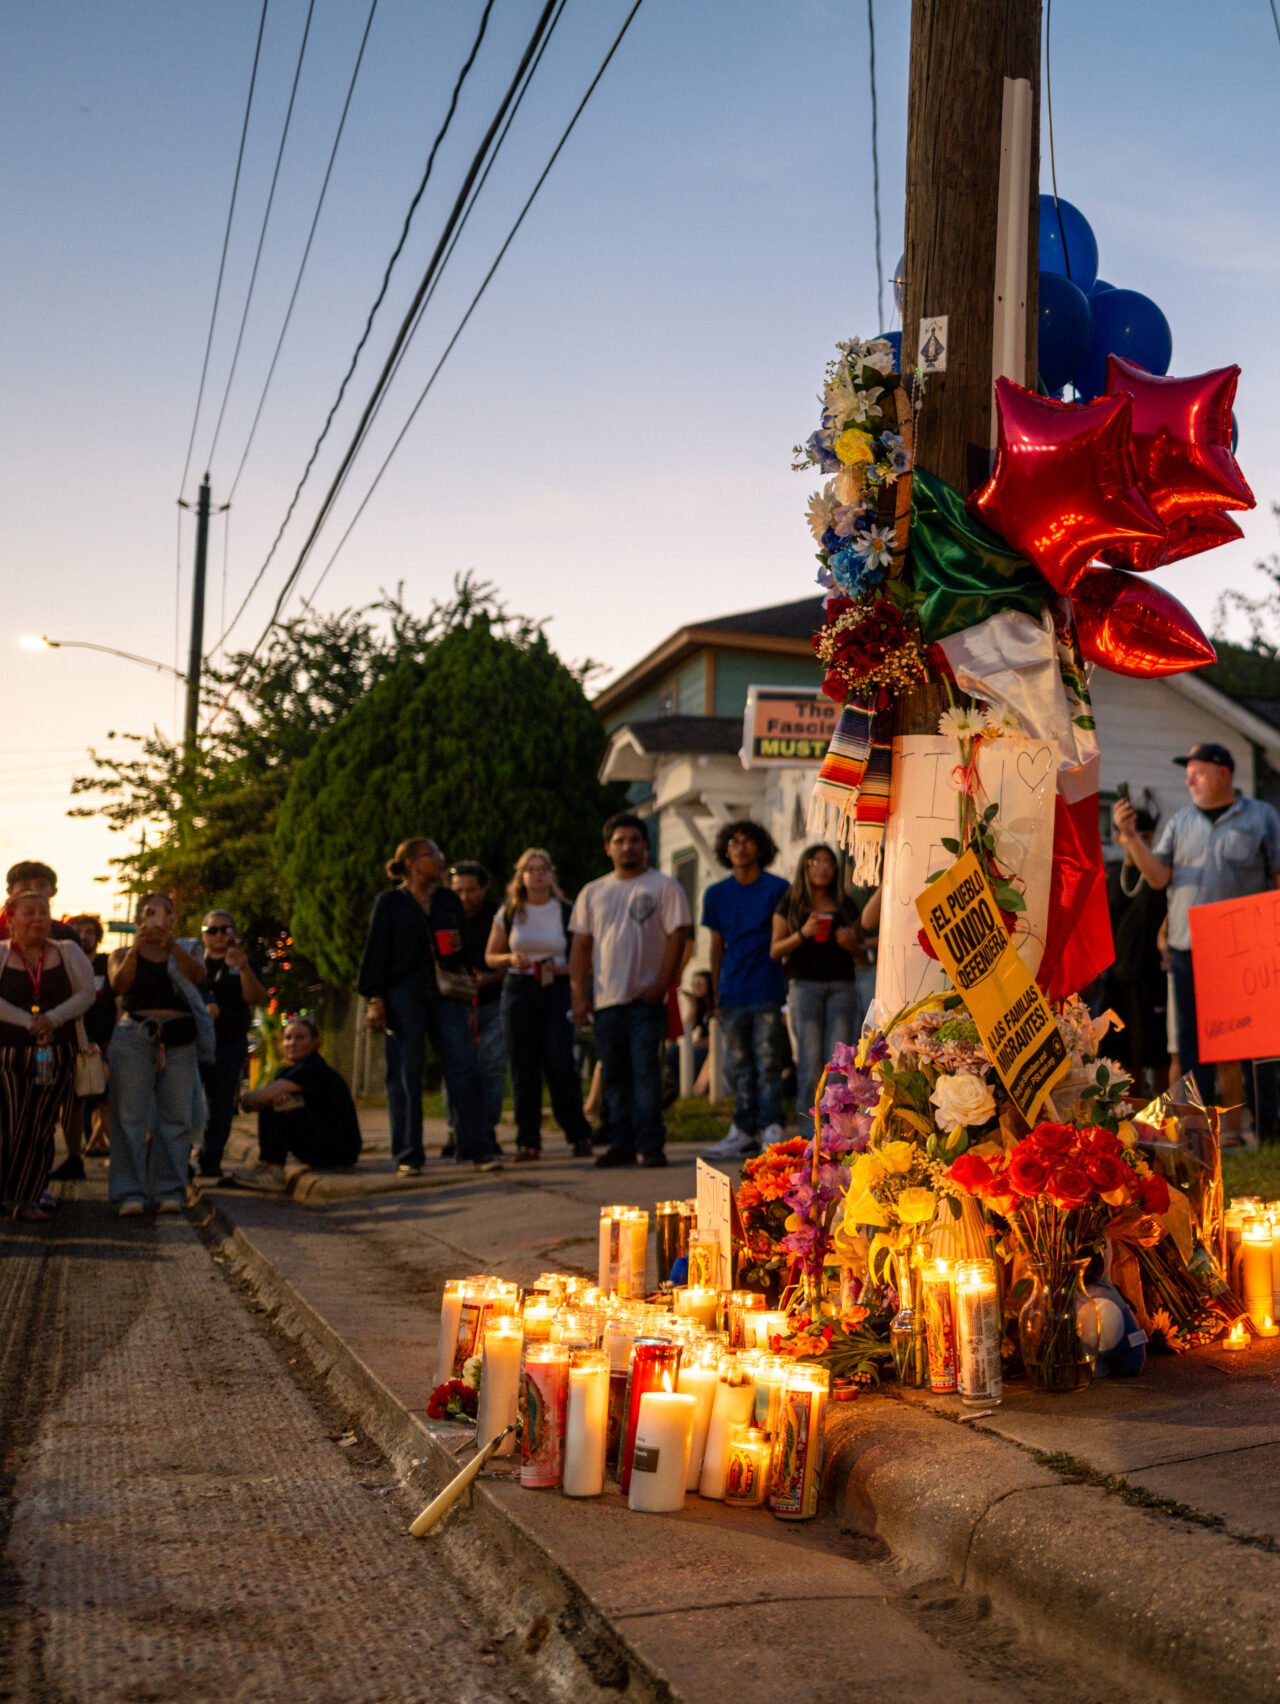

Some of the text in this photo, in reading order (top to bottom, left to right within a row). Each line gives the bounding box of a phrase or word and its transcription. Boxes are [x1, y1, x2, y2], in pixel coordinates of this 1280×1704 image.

[760, 738, 826, 757] MUST
[945, 868, 985, 919] PUEBLO
[987, 985, 1039, 1054] A LAS FAMILIAS
[996, 1003, 1049, 1076] MIGRANTES!
